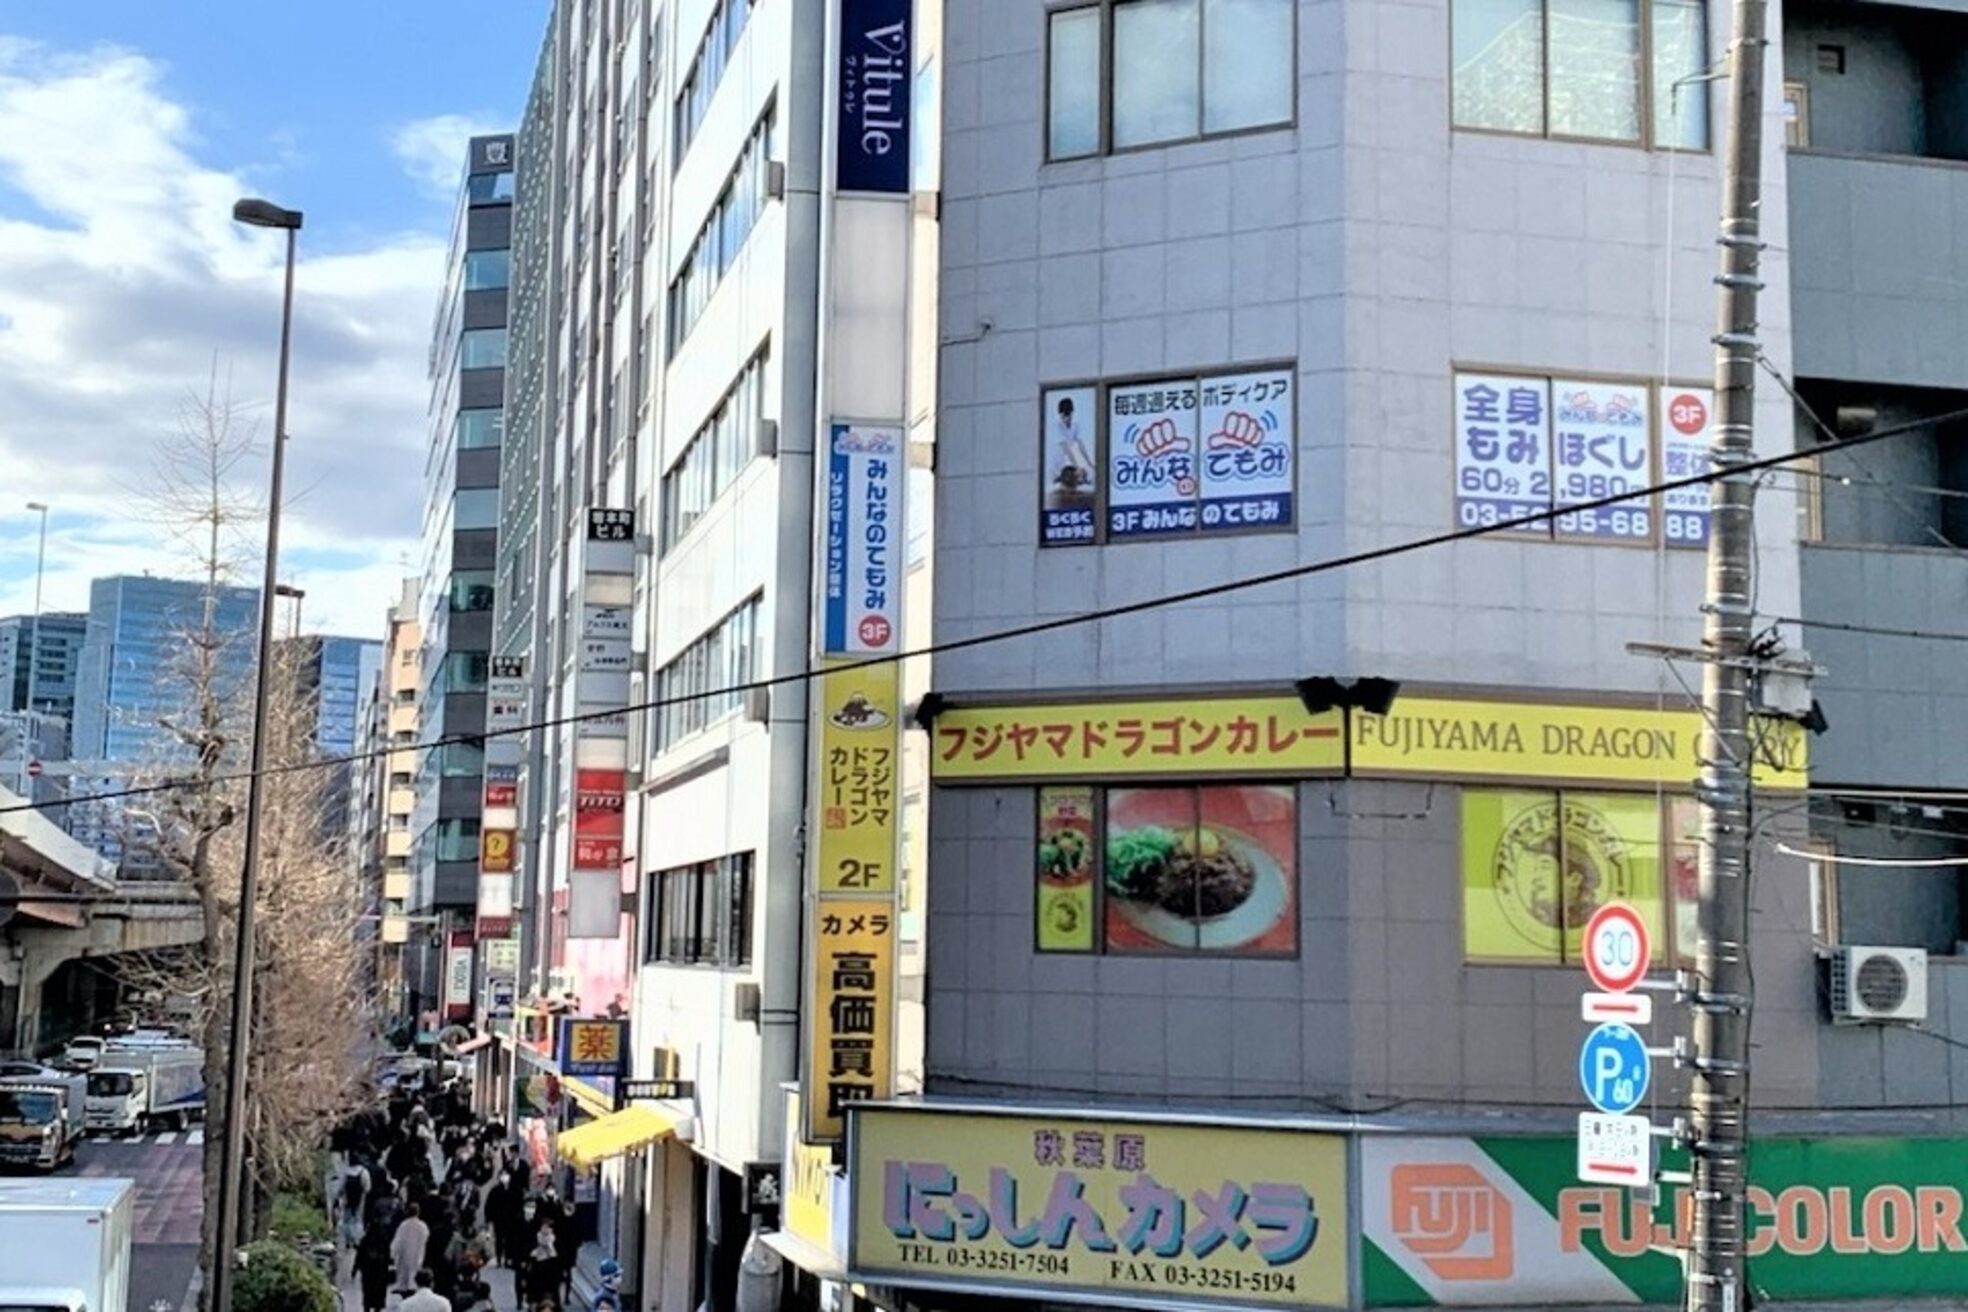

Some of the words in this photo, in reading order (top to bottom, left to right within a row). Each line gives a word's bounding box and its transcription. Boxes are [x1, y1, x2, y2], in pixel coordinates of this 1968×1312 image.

[861, 19, 907, 155] Vitule
[1463, 383, 1543, 426] 全身
[1673, 404, 1701, 425] 3F
[865, 458, 888, 610] みんなのてもみ
[1112, 511, 1140, 532] 3F
[861, 623, 888, 640] 3F
[938, 715, 1340, 761] フジヤマドラゴンカレー
[1356, 714, 1524, 754] FUJIYAMA
[1542, 724, 1677, 760] DRAGON
[830, 747, 848, 806] カレー
[851, 747, 869, 826] ドラゴン
[871, 748, 891, 827] フジヤマ
[838, 859, 881, 888] 2F
[821, 914, 889, 935] カメラ
[1601, 931, 1634, 967] 30
[578, 1025, 616, 1059] 薬
[1595, 1046, 1623, 1102] P
[1034, 1130, 1146, 1170] 秋葉原
[883, 1160, 1319, 1267] にっしんカメラ
[899, 1243, 940, 1266] TEL
[946, 1247, 1070, 1275] 03-3251-7504
[1110, 1260, 1156, 1283] FAX
[1165, 1264, 1296, 1294] 03-3251-5194
